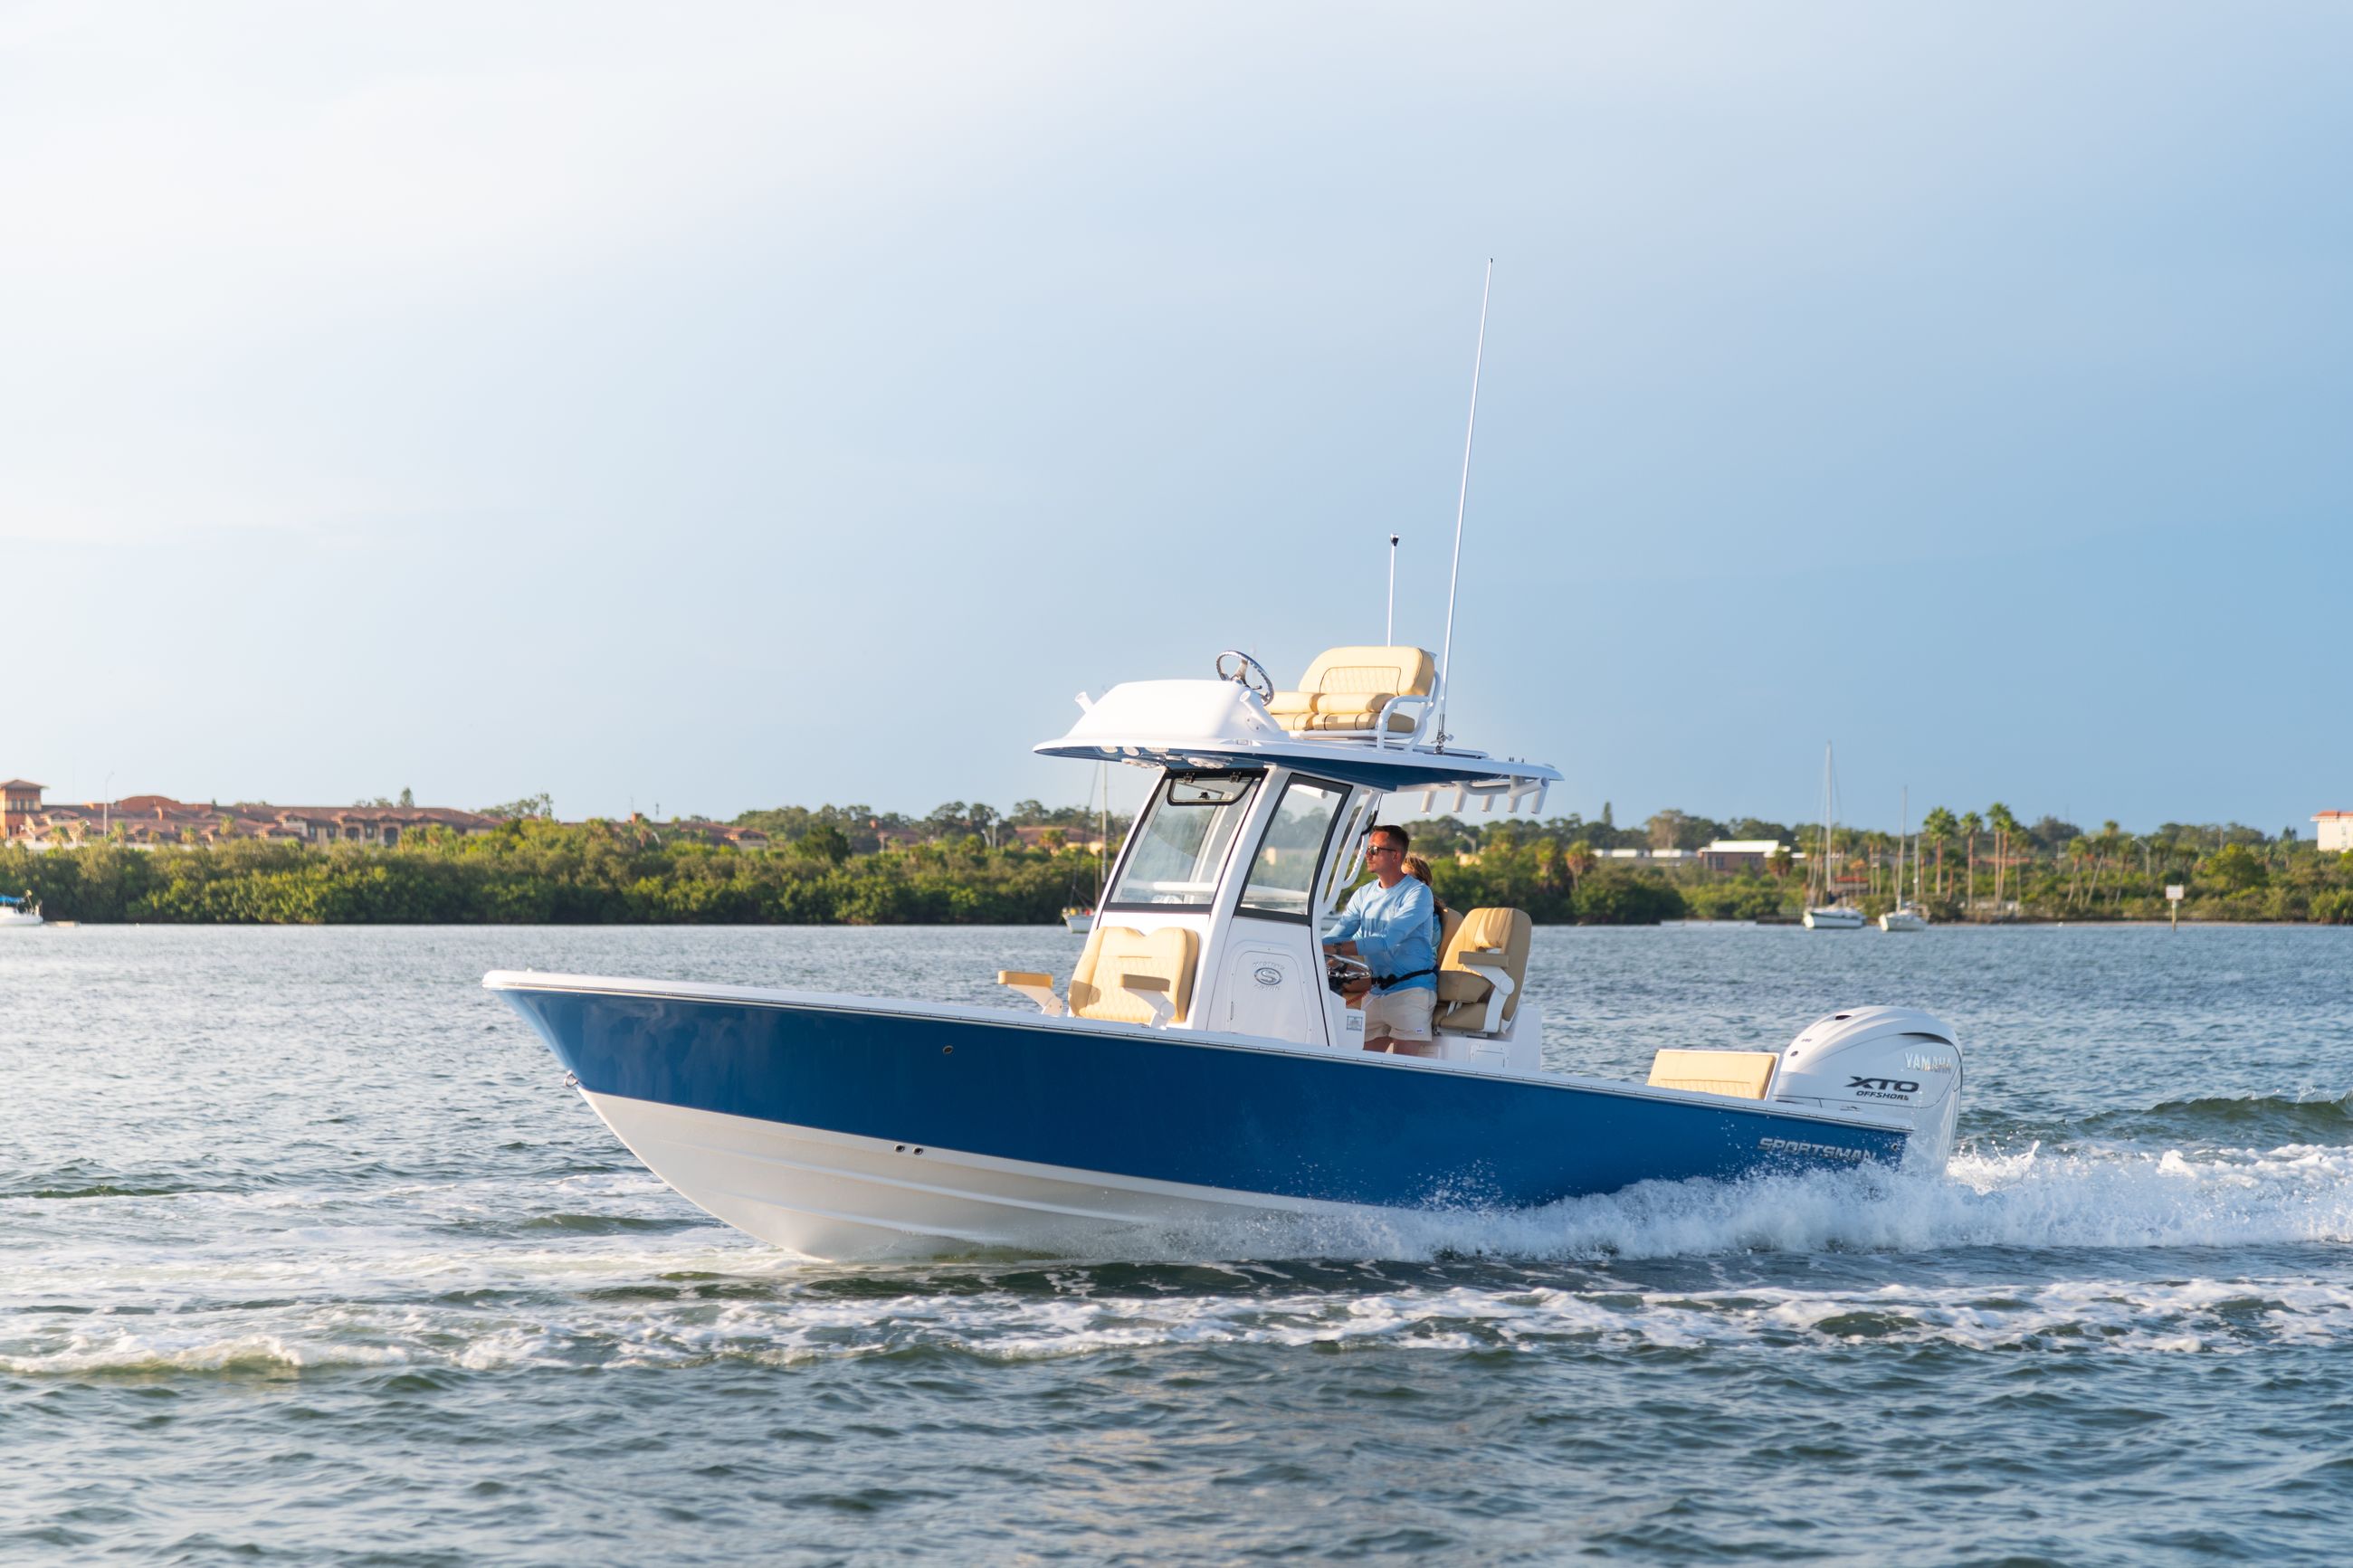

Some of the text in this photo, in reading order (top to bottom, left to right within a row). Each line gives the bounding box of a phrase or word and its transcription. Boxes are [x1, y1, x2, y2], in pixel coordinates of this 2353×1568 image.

[1844, 1076, 1920, 1093] XTO
[1856, 1090, 1910, 1101] OFFSHORE
[1758, 1137, 1877, 1161] SPORTSMAN
